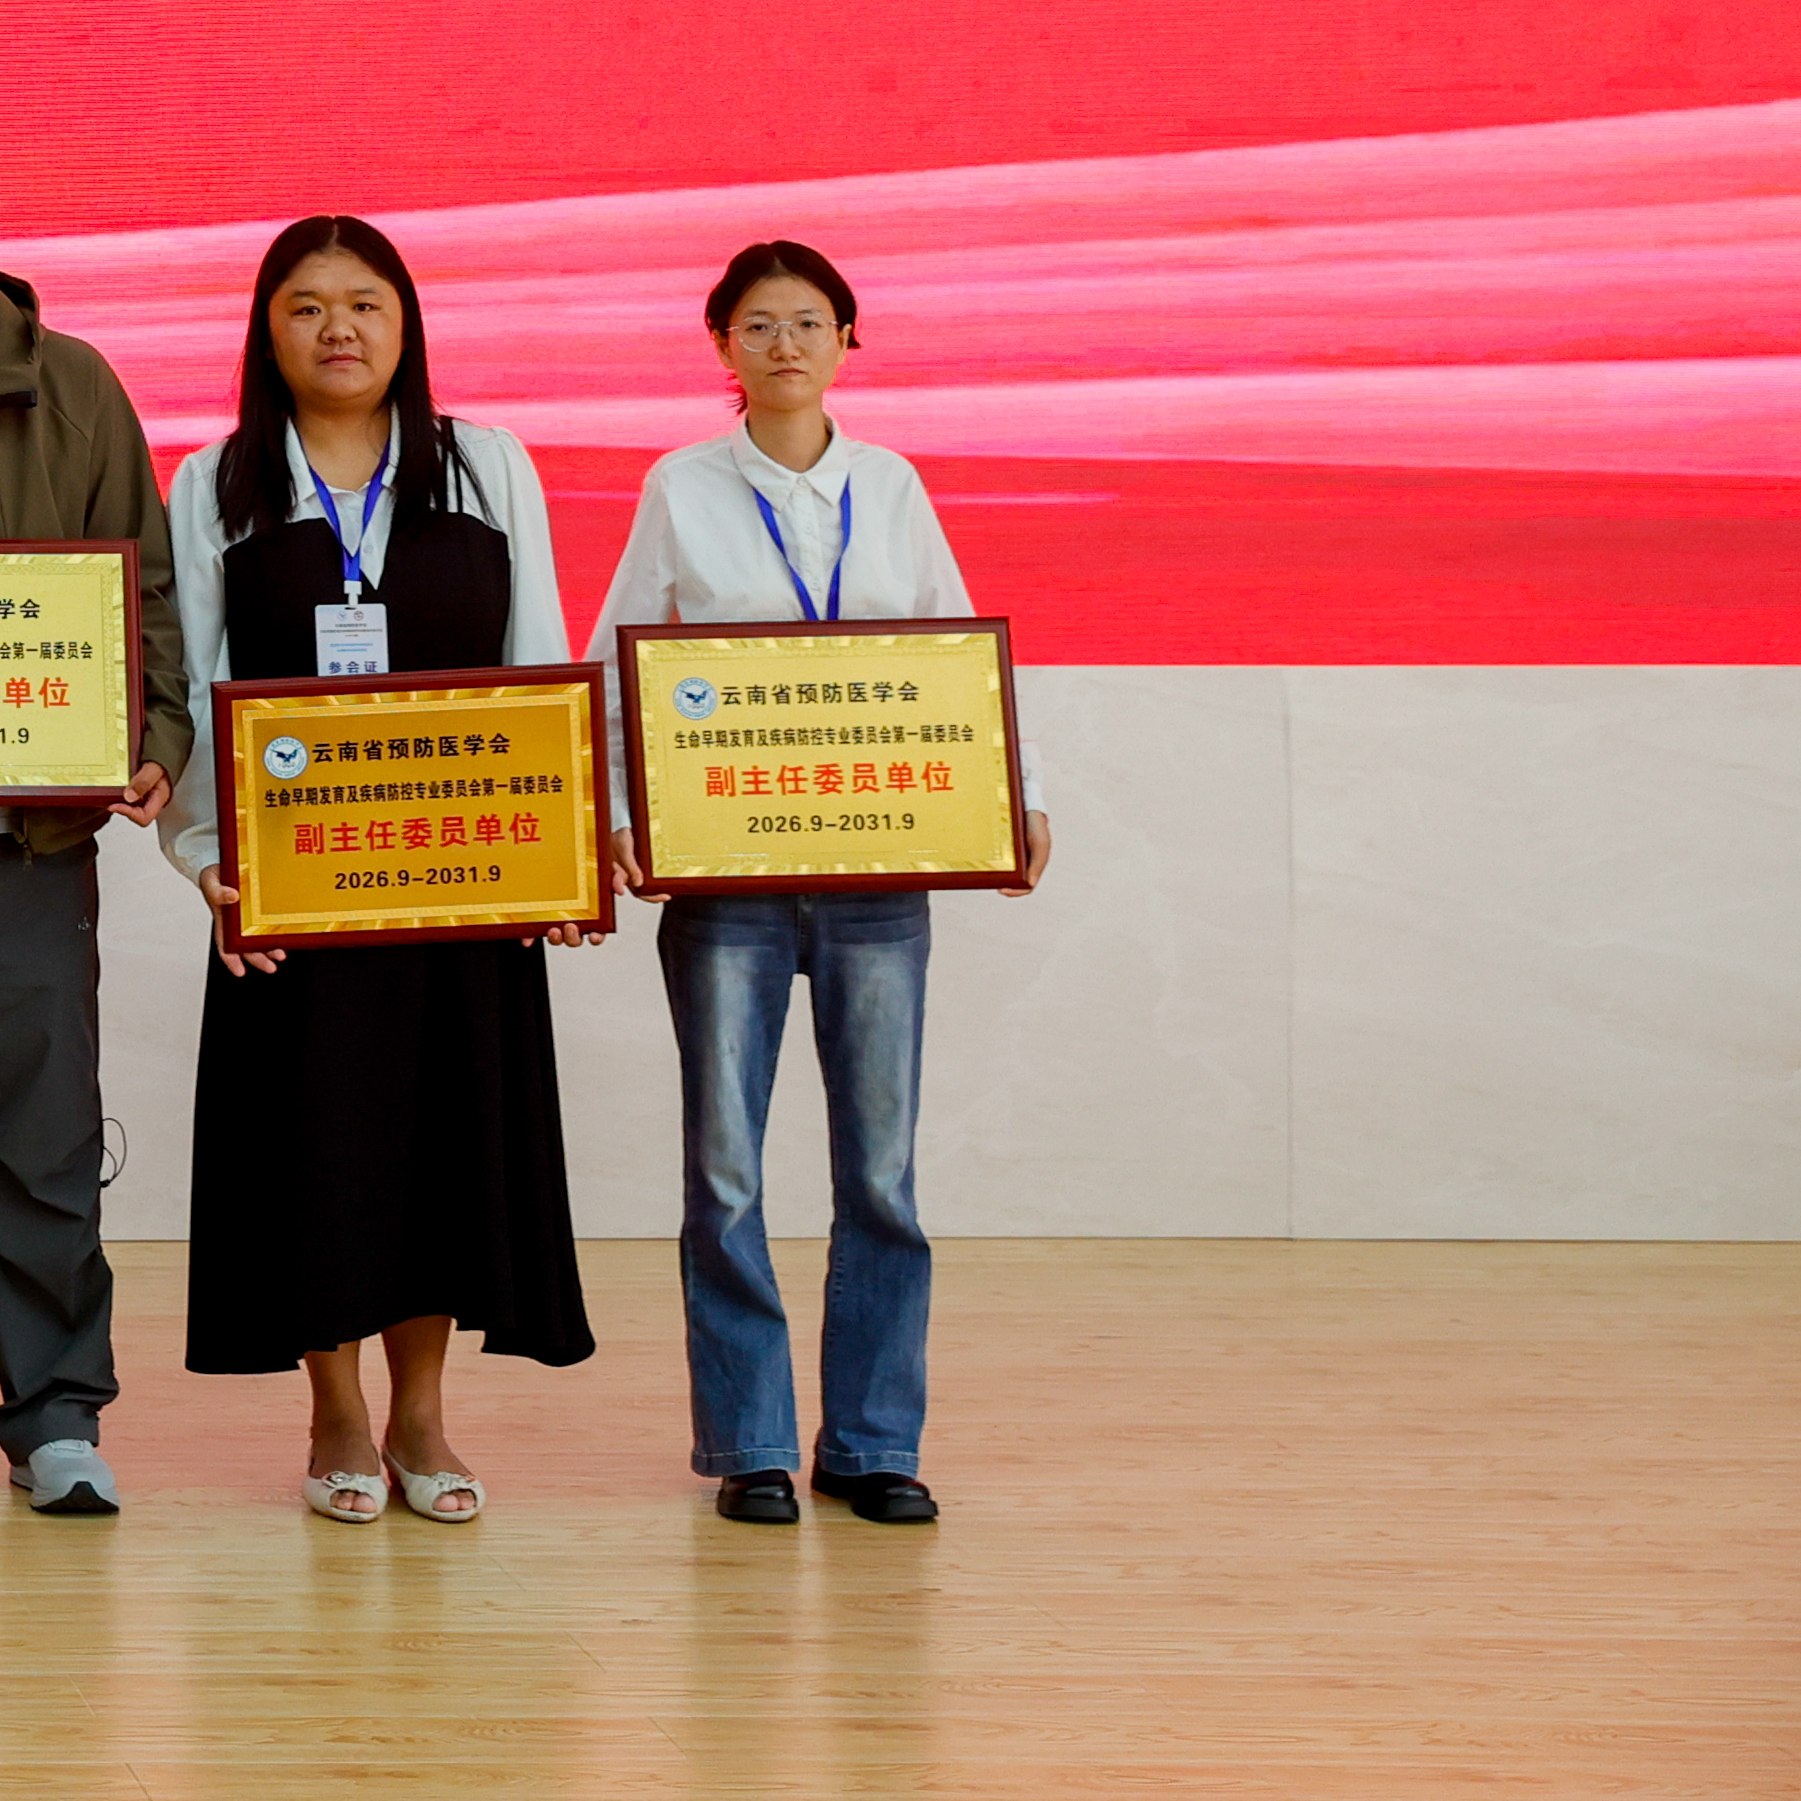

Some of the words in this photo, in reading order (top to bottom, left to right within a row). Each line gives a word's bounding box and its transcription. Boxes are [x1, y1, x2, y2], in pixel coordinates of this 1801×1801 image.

[328, 660, 378, 674] 参会证
[720, 681, 919, 706] 云南省预防医学会
[312, 733, 510, 764] 云南省预防医学会
[675, 724, 974, 749] 生命早期发育及疾病防控专业委员会第一届委员会
[264, 775, 563, 808] 生命早期发育及疾病防控专业委员会第一届委员会
[705, 761, 954, 797] 副主任委员单位
[293, 812, 541, 855] 副主任委员单位
[747, 813, 915, 834] 2026.9-2031.9
[334, 864, 501, 890] 2026.9-2031.9
